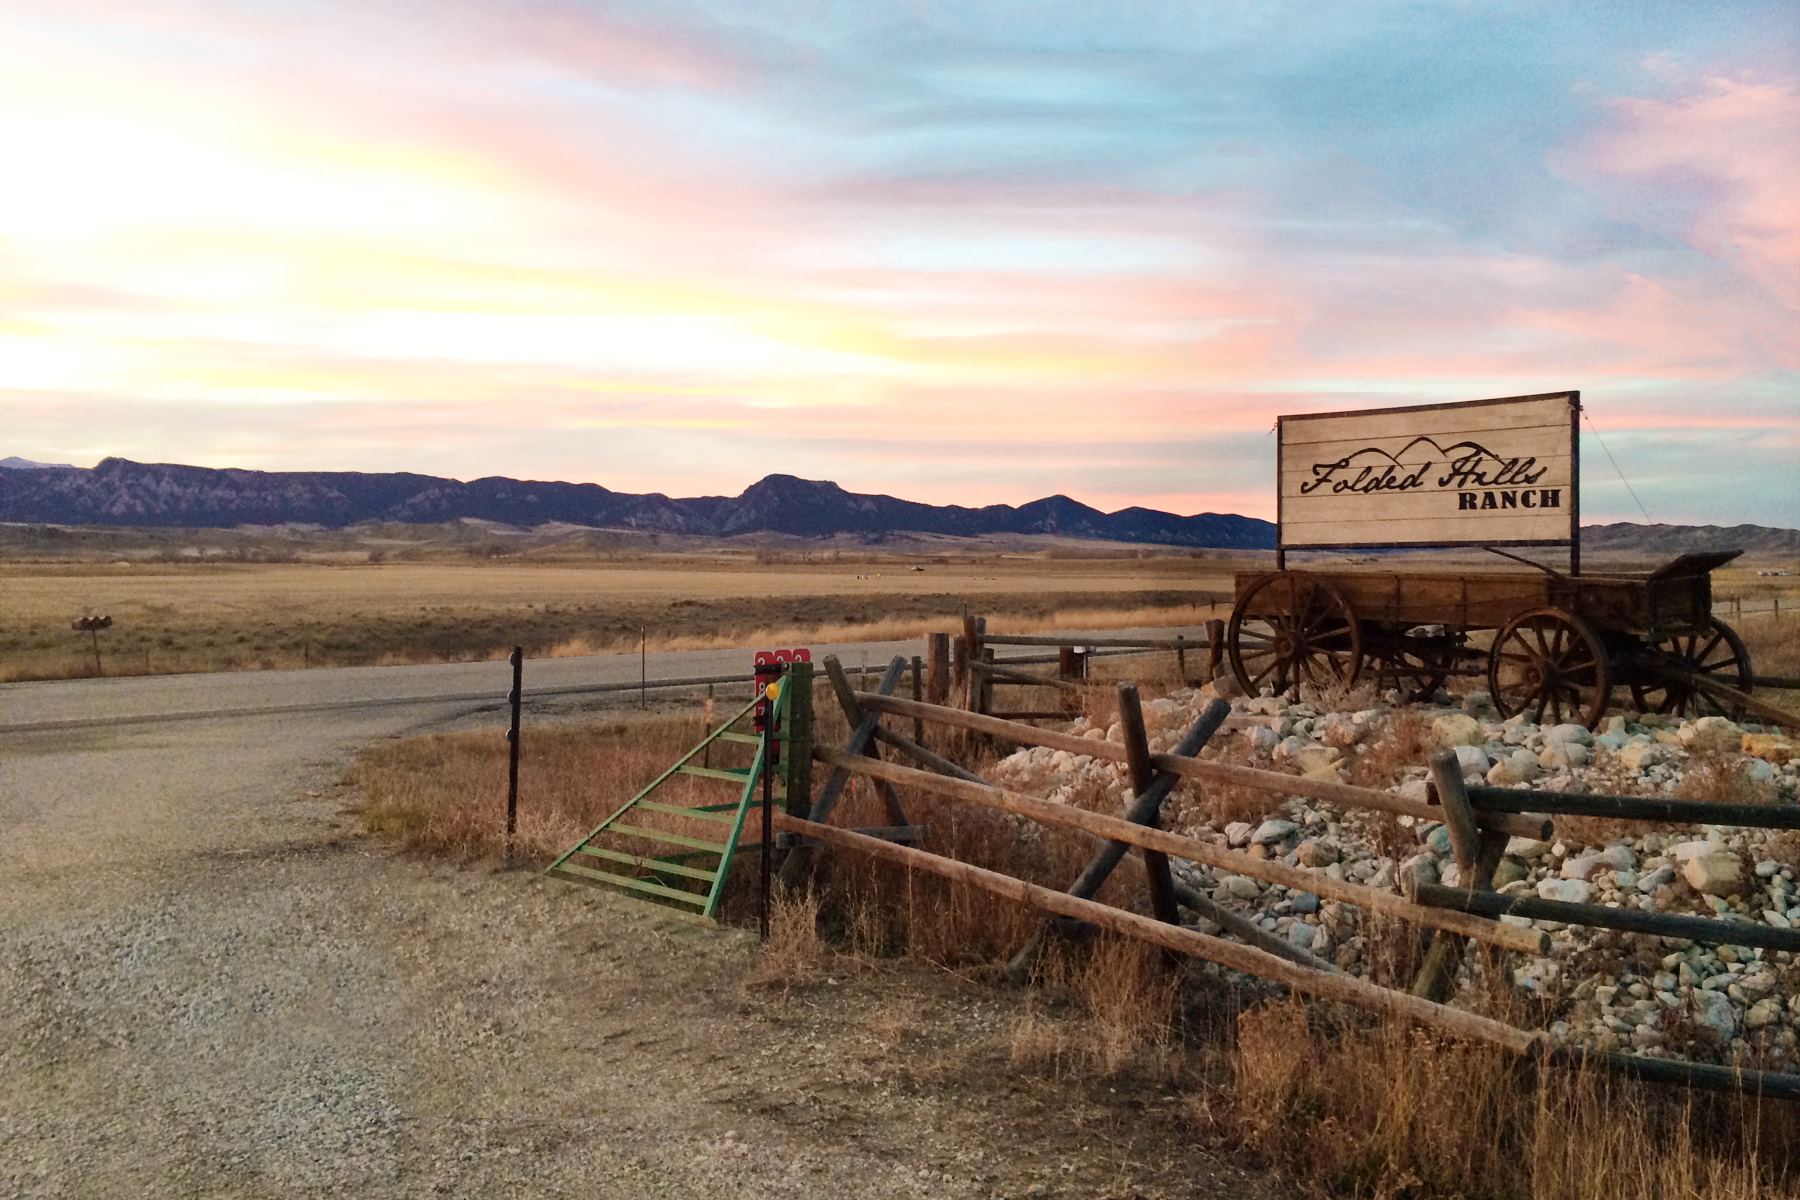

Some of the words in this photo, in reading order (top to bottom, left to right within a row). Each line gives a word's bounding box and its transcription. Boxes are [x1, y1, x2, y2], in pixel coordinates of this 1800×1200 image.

[1301, 458, 1432, 494] Folded
[1438, 447, 1547, 488] Hills
[1458, 489, 1561, 510] RANCH
